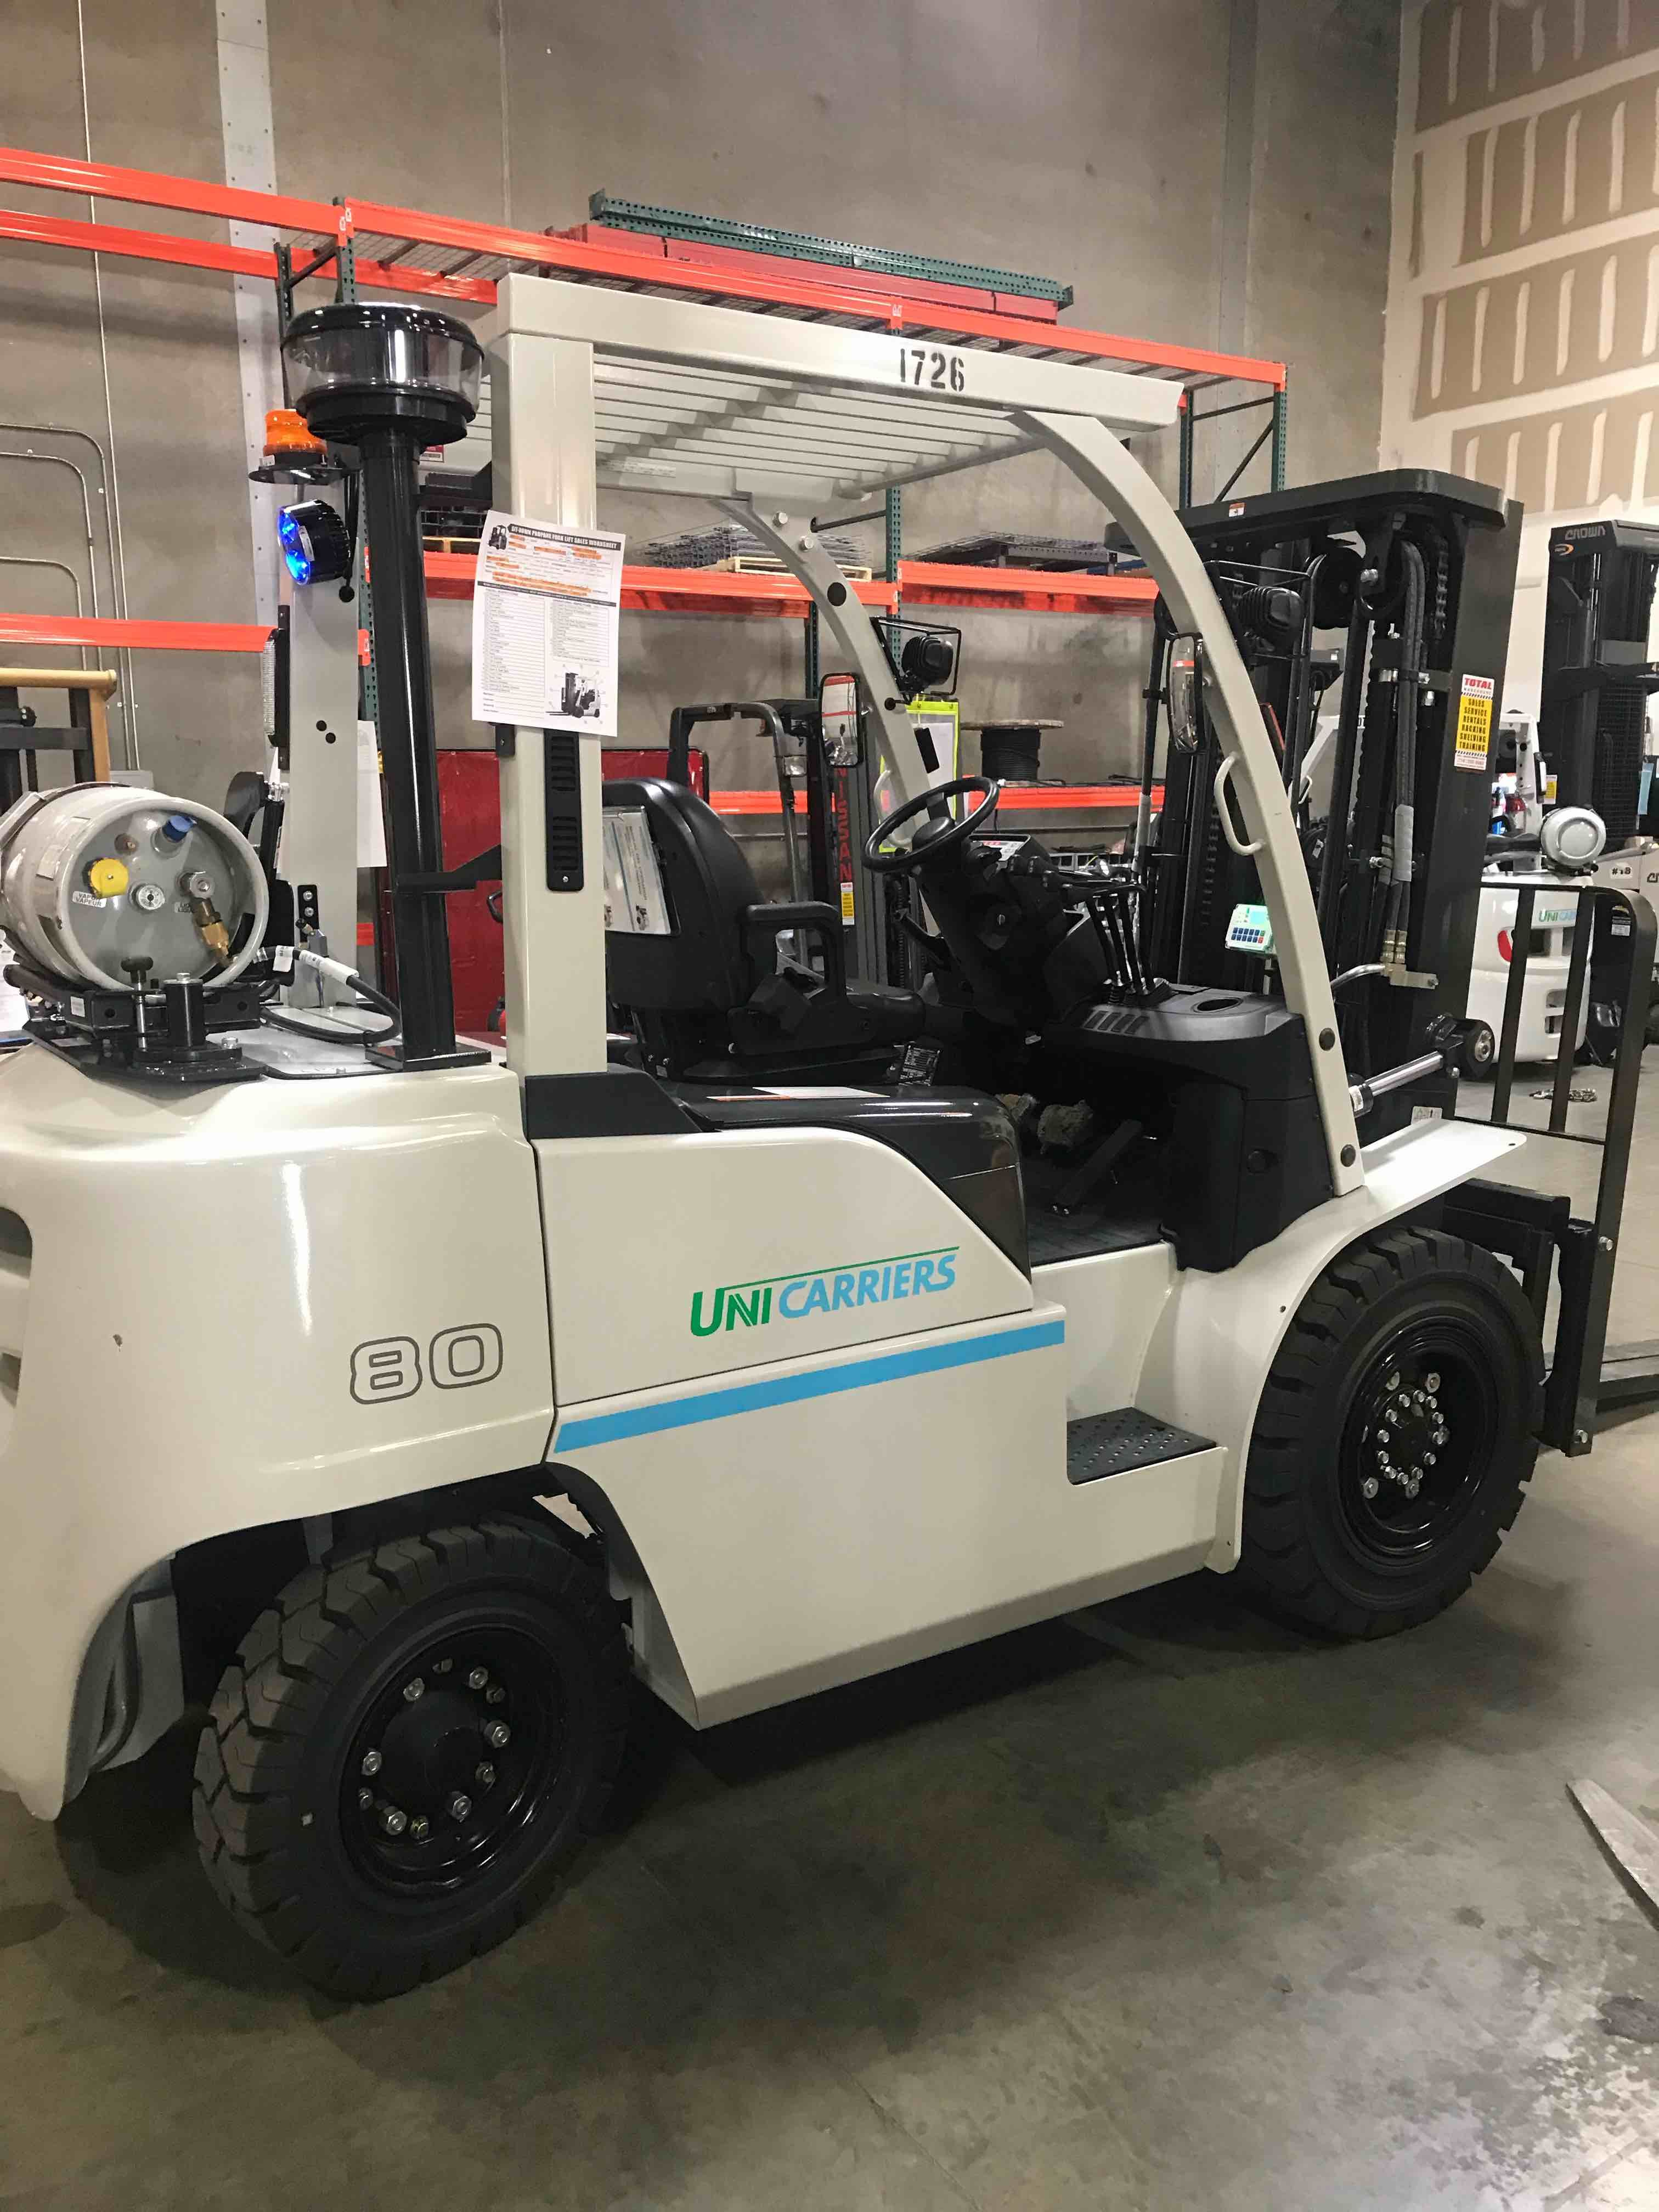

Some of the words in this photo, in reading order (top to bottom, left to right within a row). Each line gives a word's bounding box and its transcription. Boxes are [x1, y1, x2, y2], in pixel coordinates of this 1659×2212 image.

[900, 348, 964, 392] 1726
[1565, 525, 1606, 540] CROWN
[532, 529, 552, 539] PROPANE
[552, 533, 564, 542] FORK
[589, 539, 618, 549] WORKSHEET
[1465, 678, 1492, 690] TOTAL
[1468, 698, 1485, 708] SALES
[1464, 706, 1487, 717] SERVICE
[1463, 715, 1487, 726] RENTALS
[1462, 724, 1486, 735] RACKING
[1460, 733, 1486, 743] SHELVING
[1459, 742, 1485, 752] TRAINING
[834, 768, 853, 882] NISSAN
[1612, 867, 1631, 876] #18
[690, 1251, 958, 1337] UNICARRIERS
[349, 1323, 504, 1405] 80
